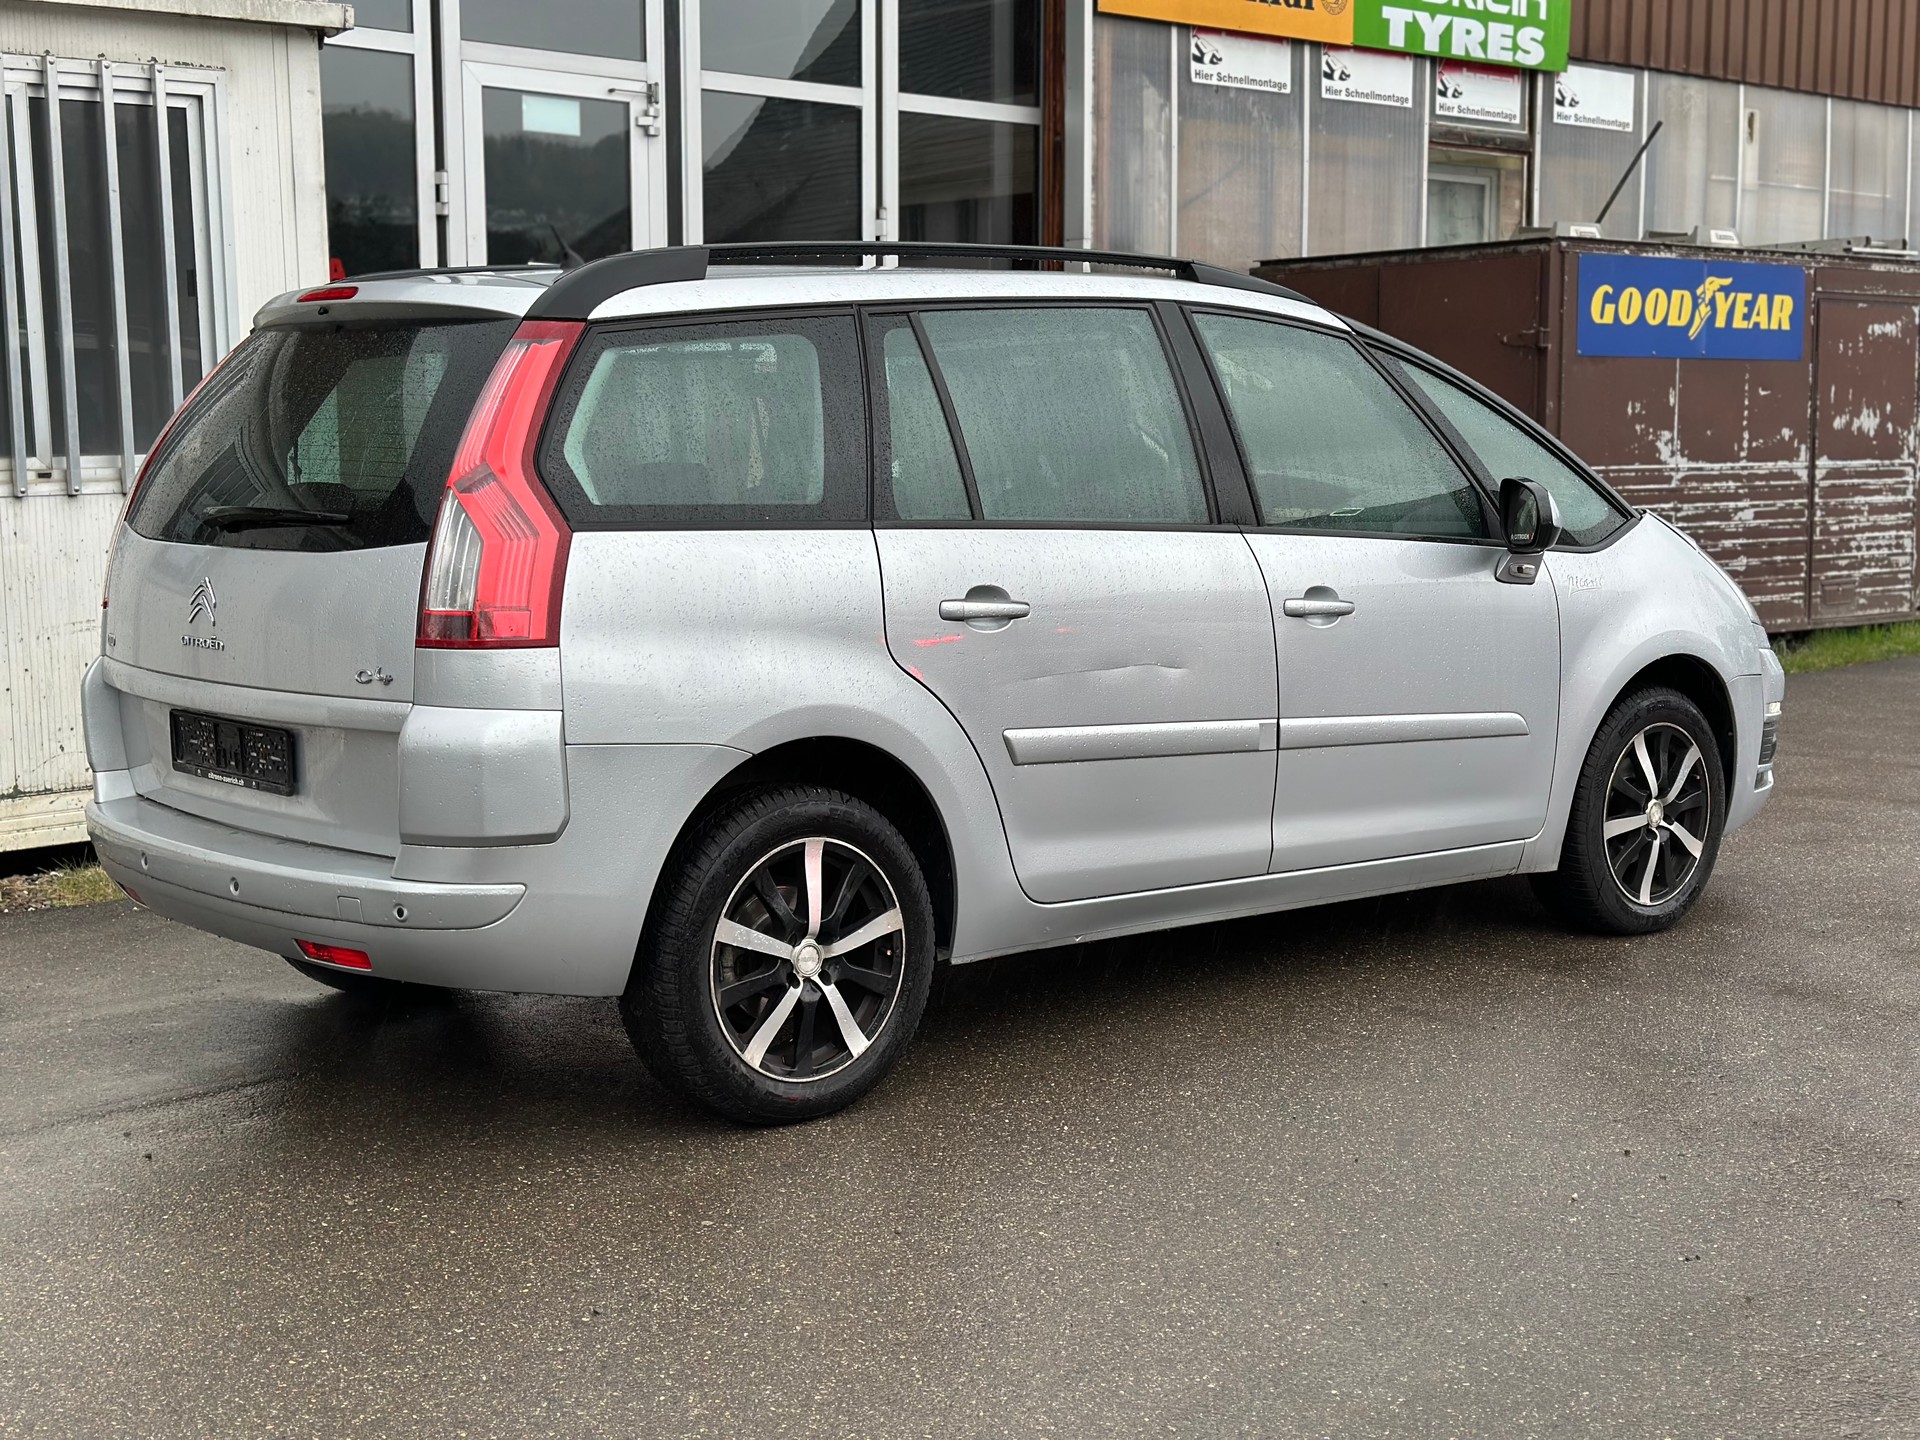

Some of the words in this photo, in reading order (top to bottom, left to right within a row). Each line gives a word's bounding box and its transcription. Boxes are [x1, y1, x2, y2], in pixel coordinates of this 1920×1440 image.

[1382, 5, 1545, 66] TYRES
[1194, 69, 1214, 81] Hier
[1216, 72, 1288, 91] Schnellmontage
[1325, 85, 1343, 96] Hier
[1345, 87, 1409, 105] Schnellmontage
[1438, 102, 1455, 113] Hier
[1457, 104, 1517, 121] Schnellmontage
[1556, 111, 1572, 121] Hier
[1573, 113, 1630, 129] Schnellmontage
